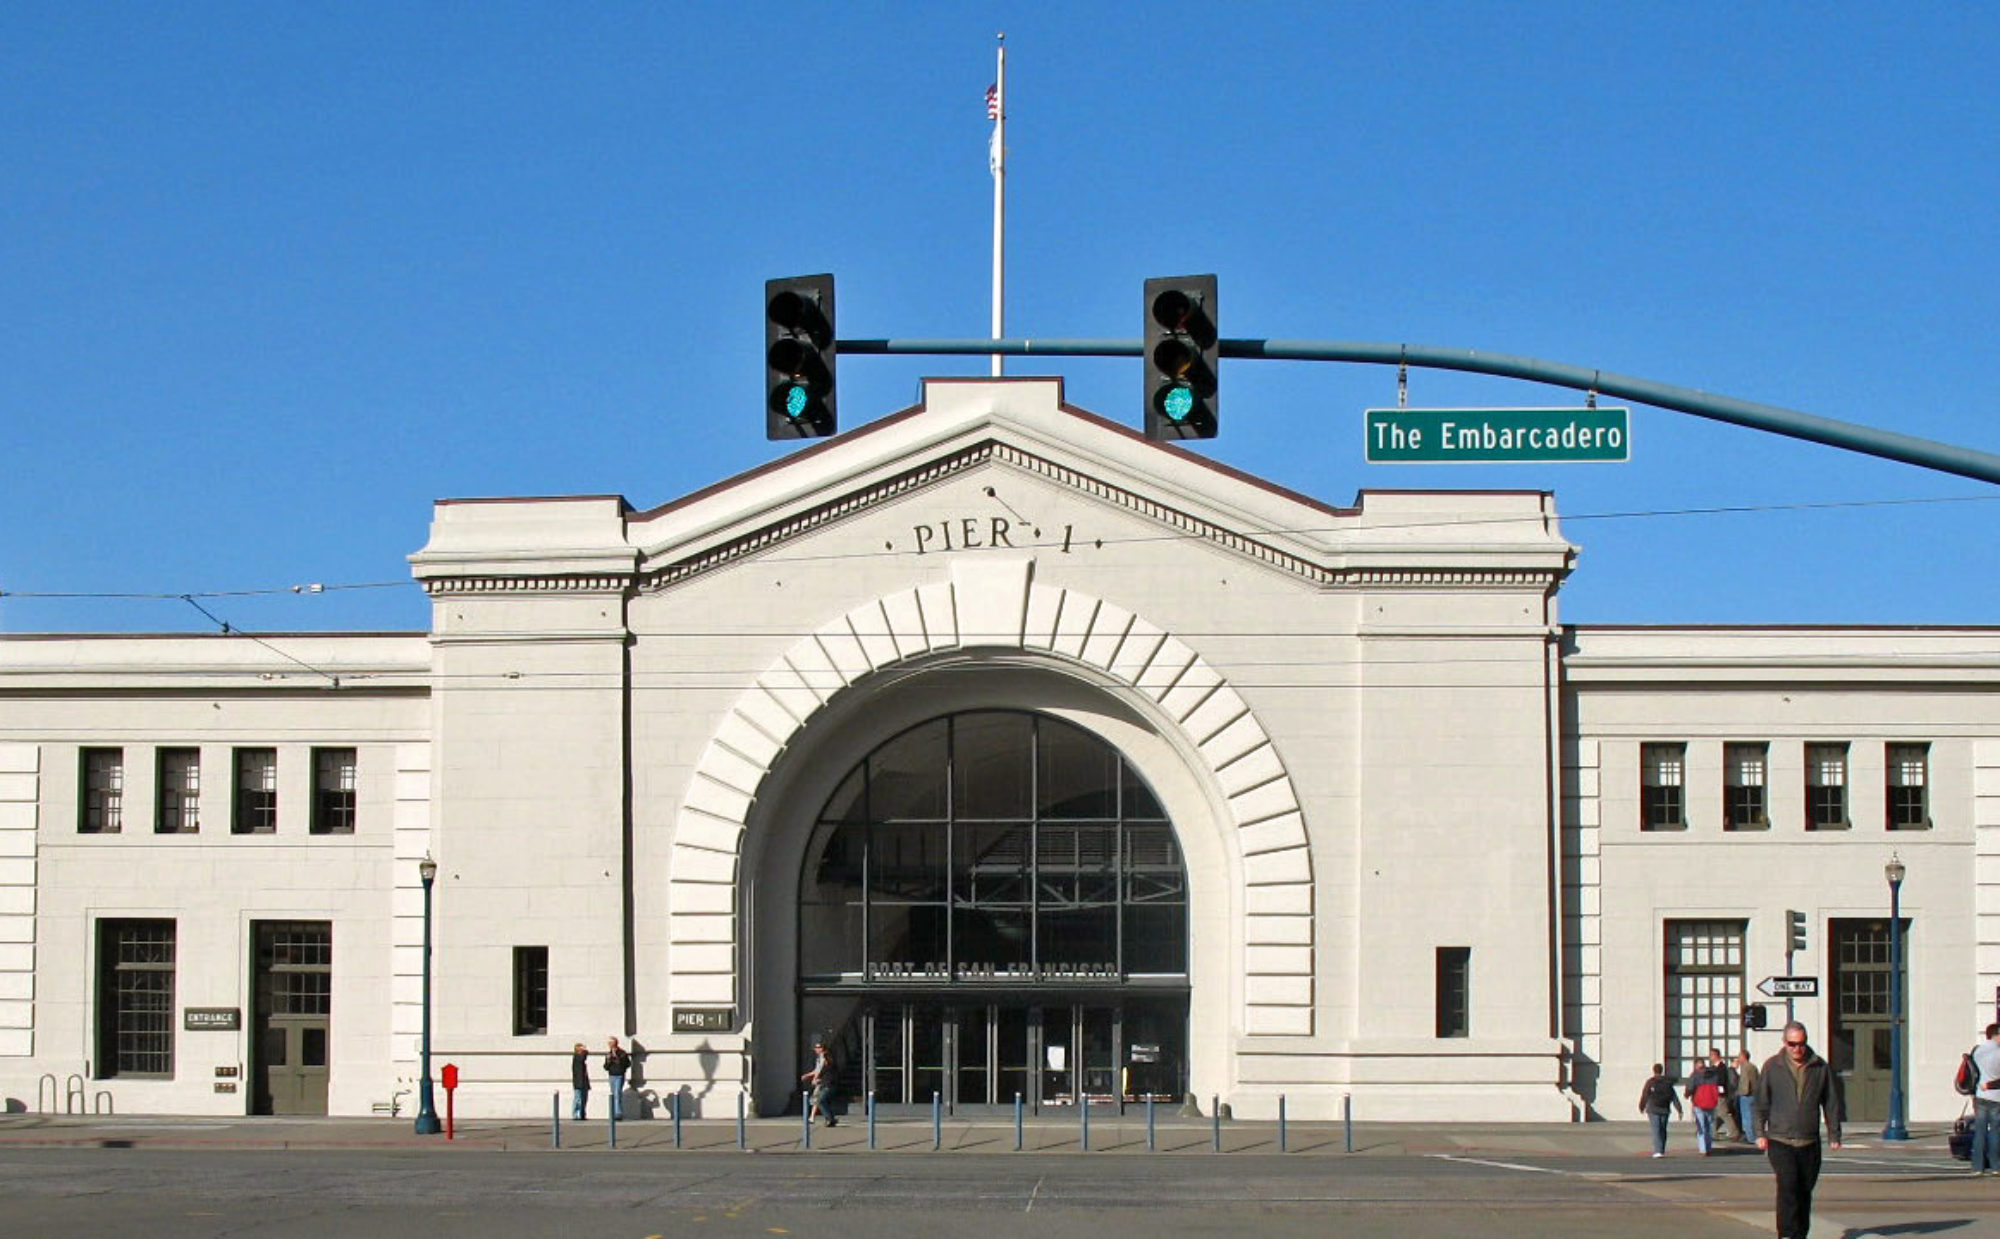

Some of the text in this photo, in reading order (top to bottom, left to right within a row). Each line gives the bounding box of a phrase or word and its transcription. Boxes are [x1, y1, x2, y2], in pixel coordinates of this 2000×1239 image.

[1374, 421, 1621, 450] The Embarcadero
[913, 517, 1072, 554] PIER 1
[868, 962, 1118, 979] PORT OF SAN FRANCISCO
[187, 1013, 233, 1021] ENTRANCE
[677, 1013, 704, 1026] PIER
